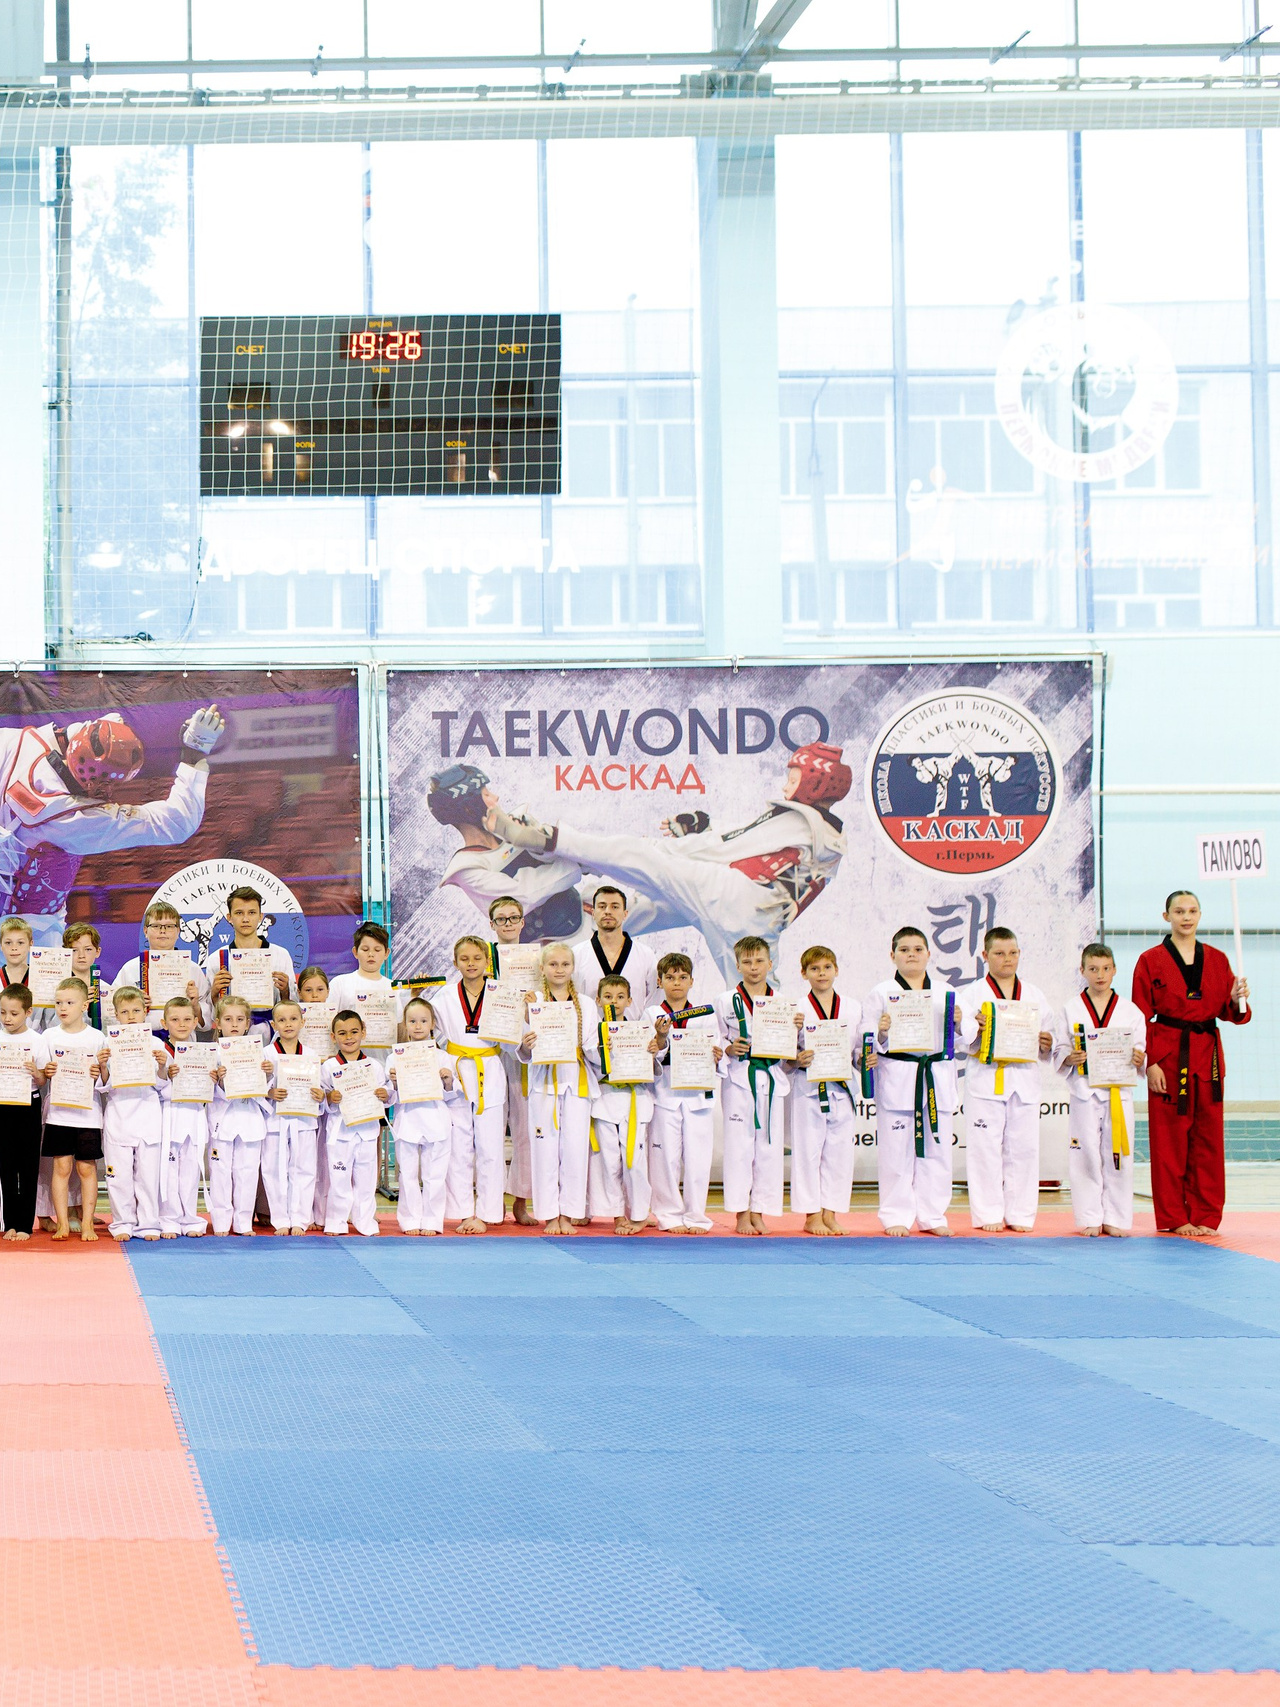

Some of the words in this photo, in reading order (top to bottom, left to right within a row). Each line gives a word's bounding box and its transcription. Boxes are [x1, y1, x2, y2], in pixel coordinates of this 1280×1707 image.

[235, 345, 264, 355] СЧЕТ
[350, 330, 422, 360] 19:26
[498, 344, 528, 354] СЧЕТ
[199, 538, 380, 581] ДВОРЕЦ
[395, 538, 580, 574] СПОРТА
[431, 706, 830, 758] TAEKWONDO
[884, 703, 948, 758] ПЛАСТИКИ
[955, 700, 964, 709] И
[972, 701, 1027, 734] БОЕВЫХ
[917, 720, 1010, 746] TAEKWONDO
[555, 763, 706, 795] КАСКАД
[902, 819, 1024, 844] КАСКАД
[936, 849, 995, 862] г.Пермь
[1202, 838, 1263, 873] ГАМОВО
[157, 865, 210, 903] ЛАСТИКИ
[217, 864, 225, 873] И
[232, 864, 283, 897] БОЕВЫХ
[282, 897, 305, 970] ИСКУССТВ
[673, 1006, 708, 1020] TAEKWONDO
[929, 1087, 938, 1124] TAEKWONDO
